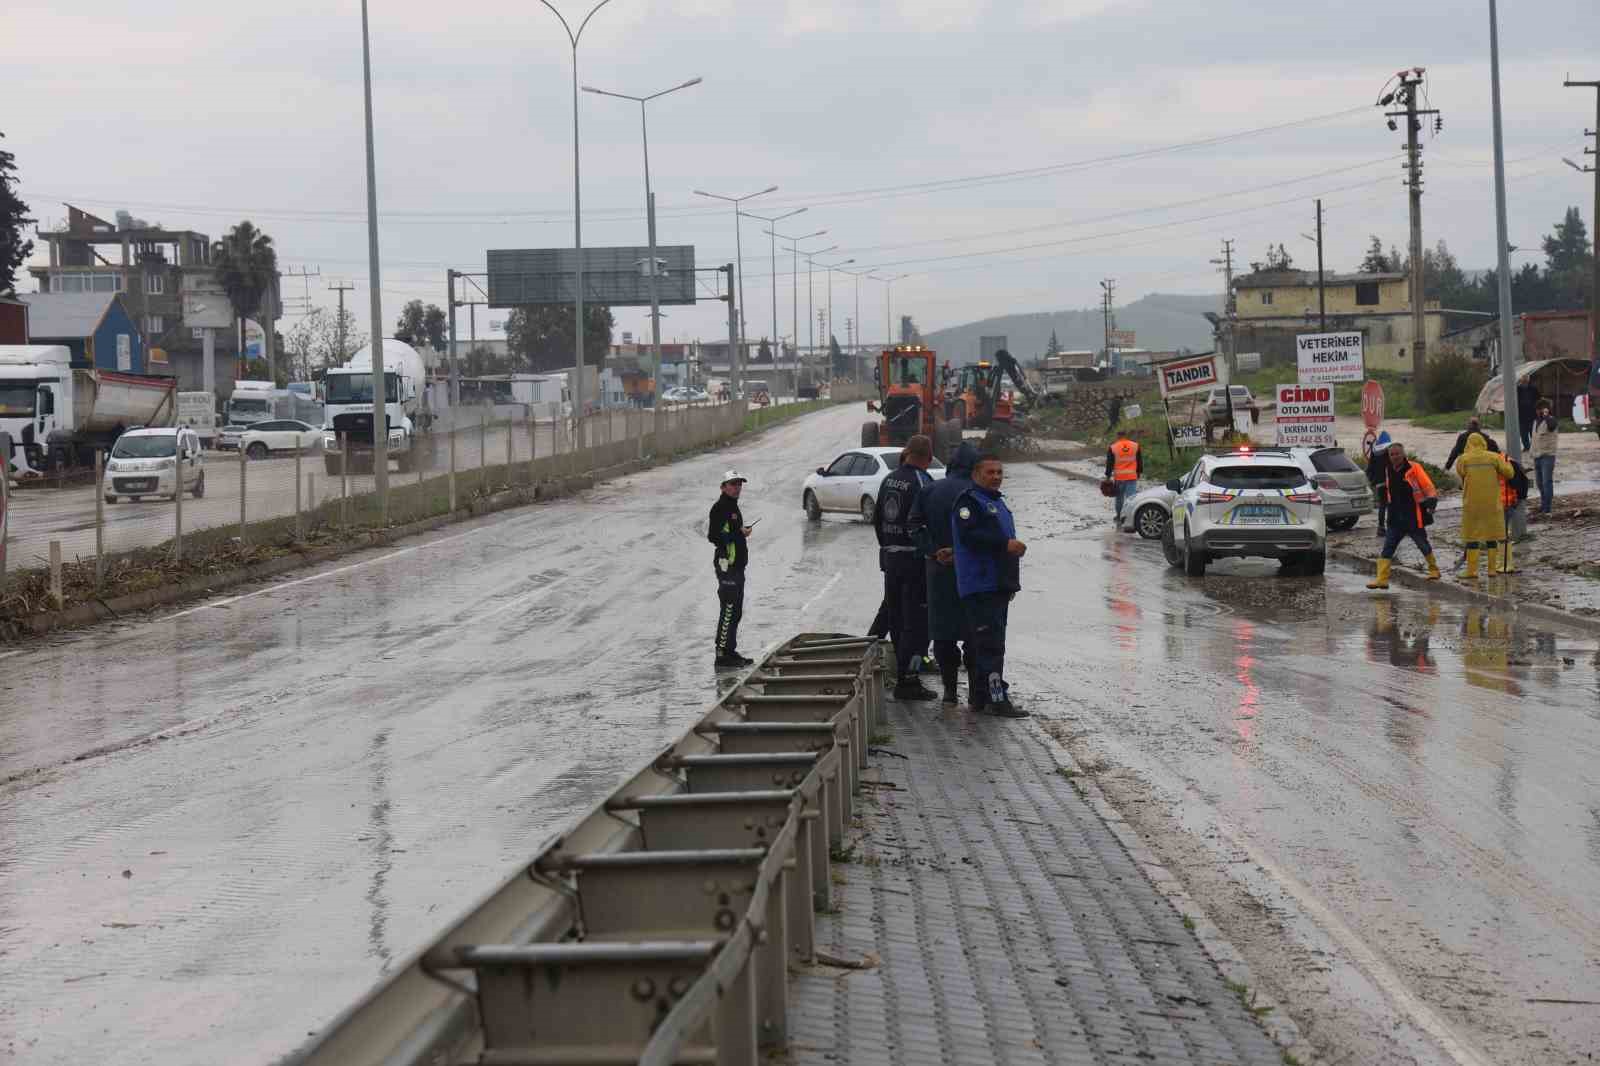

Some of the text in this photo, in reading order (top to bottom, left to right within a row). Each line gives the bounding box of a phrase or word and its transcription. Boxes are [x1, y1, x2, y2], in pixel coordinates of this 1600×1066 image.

[1299, 336, 1360, 349] VETERİNER
[1313, 351, 1348, 363] HEKİM
[1168, 364, 1210, 384] TANDIR
[1282, 404, 1329, 415] OTO TAMİR
[1362, 391, 1384, 417] DUR
